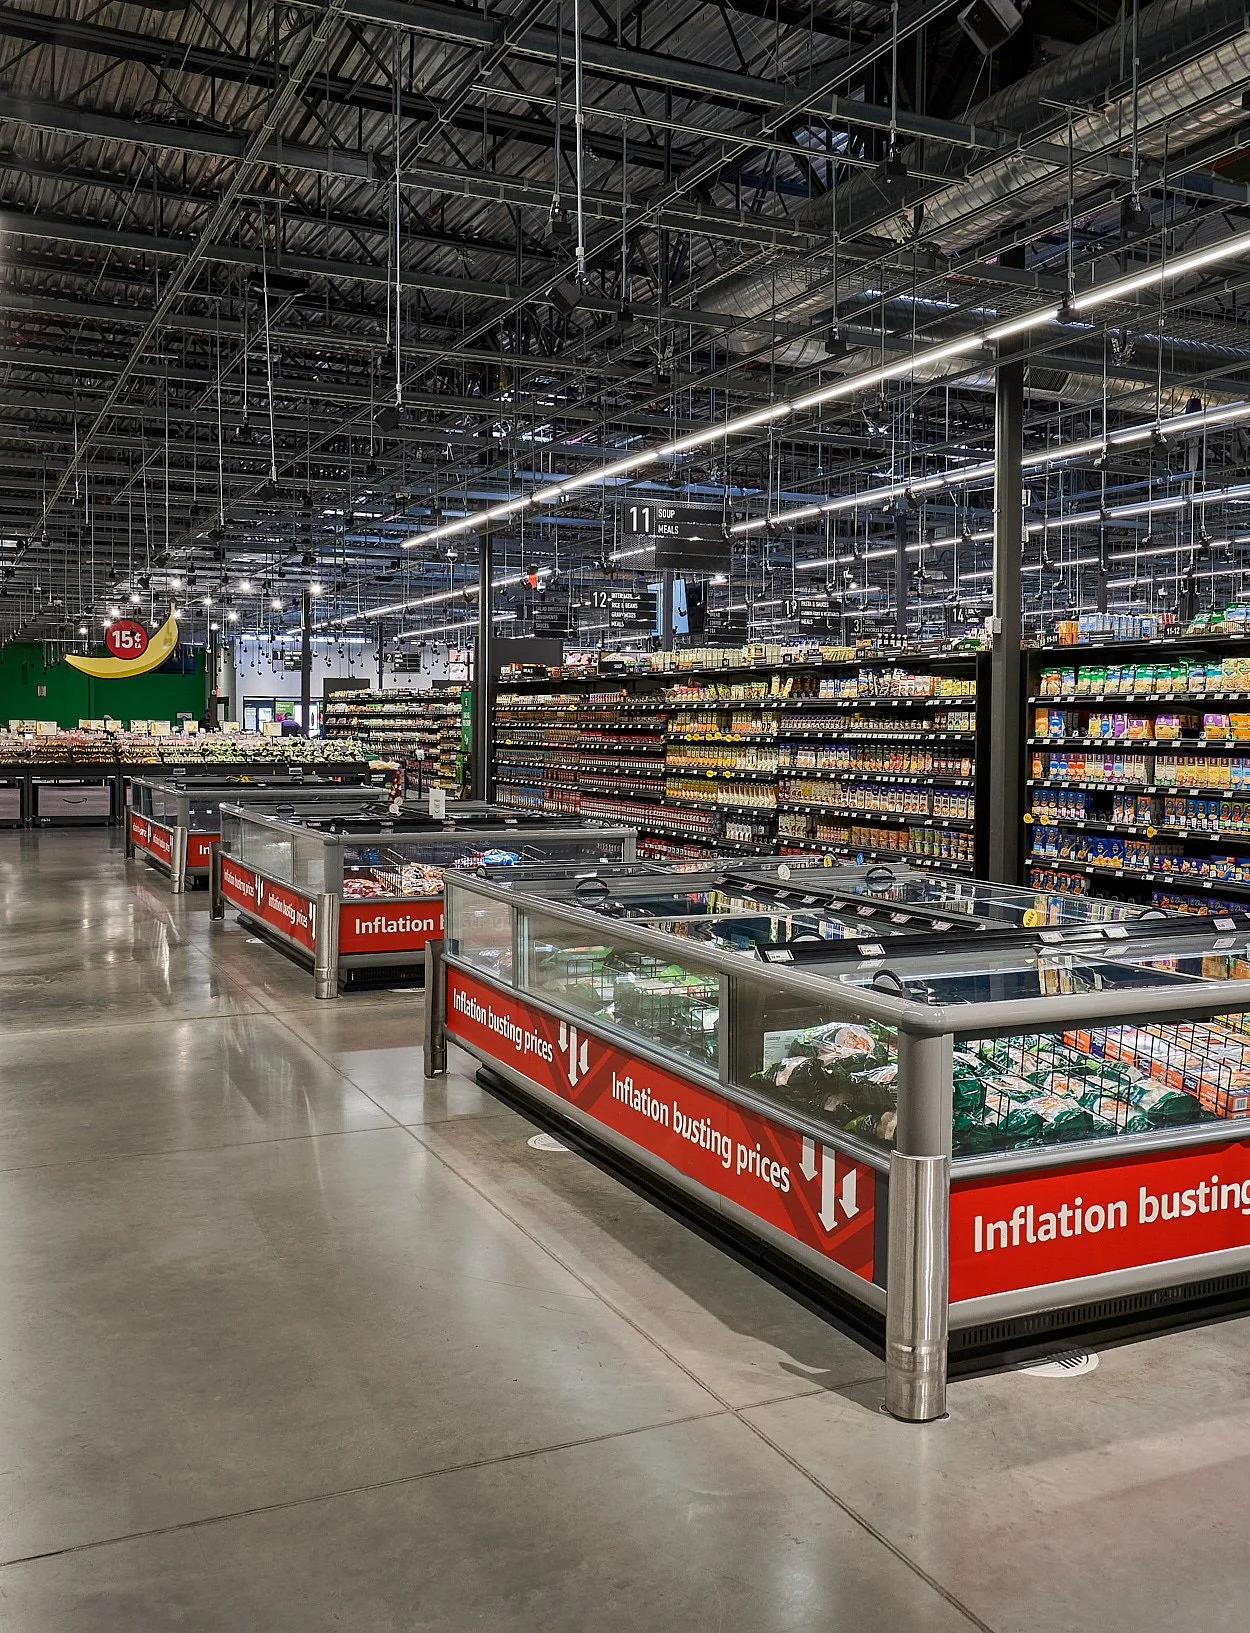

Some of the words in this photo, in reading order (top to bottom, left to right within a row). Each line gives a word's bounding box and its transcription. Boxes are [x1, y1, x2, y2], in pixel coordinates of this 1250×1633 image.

[629, 506, 650, 533] 11
[657, 508, 676, 519] SOUP
[657, 524, 679, 535] MEALS
[592, 591, 607, 608] 12
[952, 607, 965, 623] 14
[1166, 626, 1181, 635] 11-12
[355, 915, 434, 935] Inflation
[453, 987, 487, 1026] Inflation
[488, 1005, 523, 1051] busting
[523, 1029, 553, 1063] prices
[612, 1071, 669, 1128] Inflation
[673, 1101, 732, 1169] busting
[736, 1143, 790, 1193] prices
[974, 1197, 1128, 1253] Inflation
